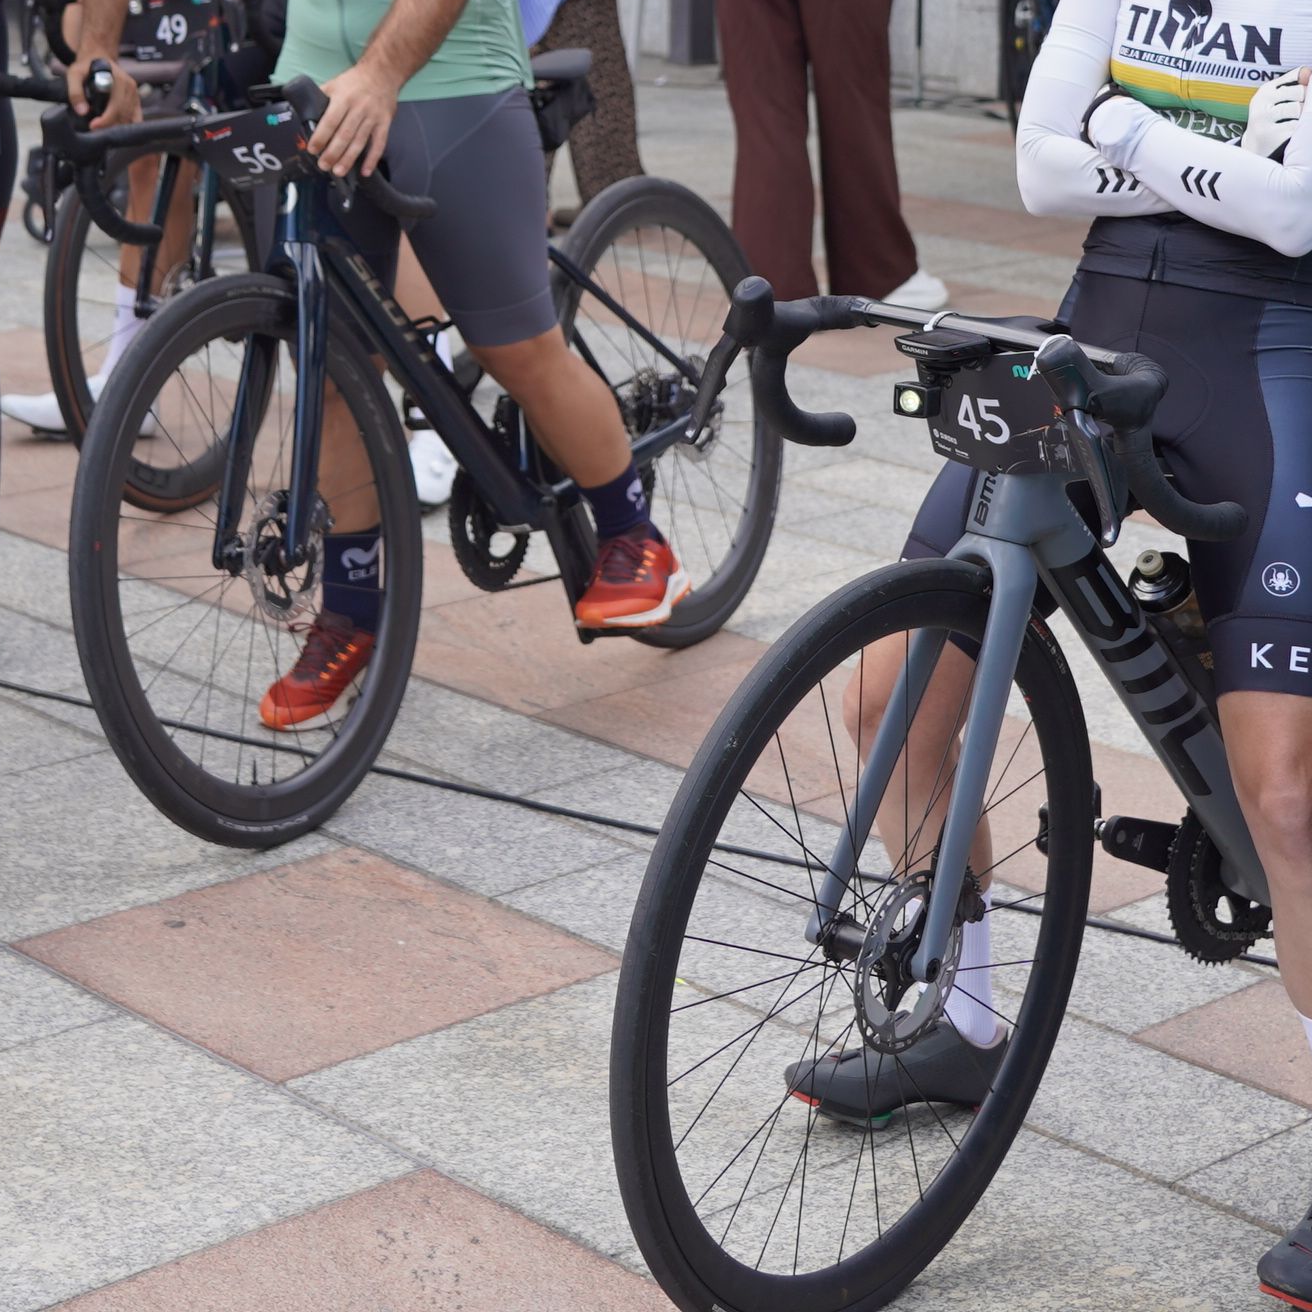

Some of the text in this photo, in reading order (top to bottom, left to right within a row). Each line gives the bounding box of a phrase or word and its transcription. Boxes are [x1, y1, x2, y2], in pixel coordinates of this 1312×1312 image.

[156, 13, 188, 46] 49
[232, 141, 283, 174] 56
[901, 344, 929, 356] GARMIN
[957, 393, 1011, 445] 45
